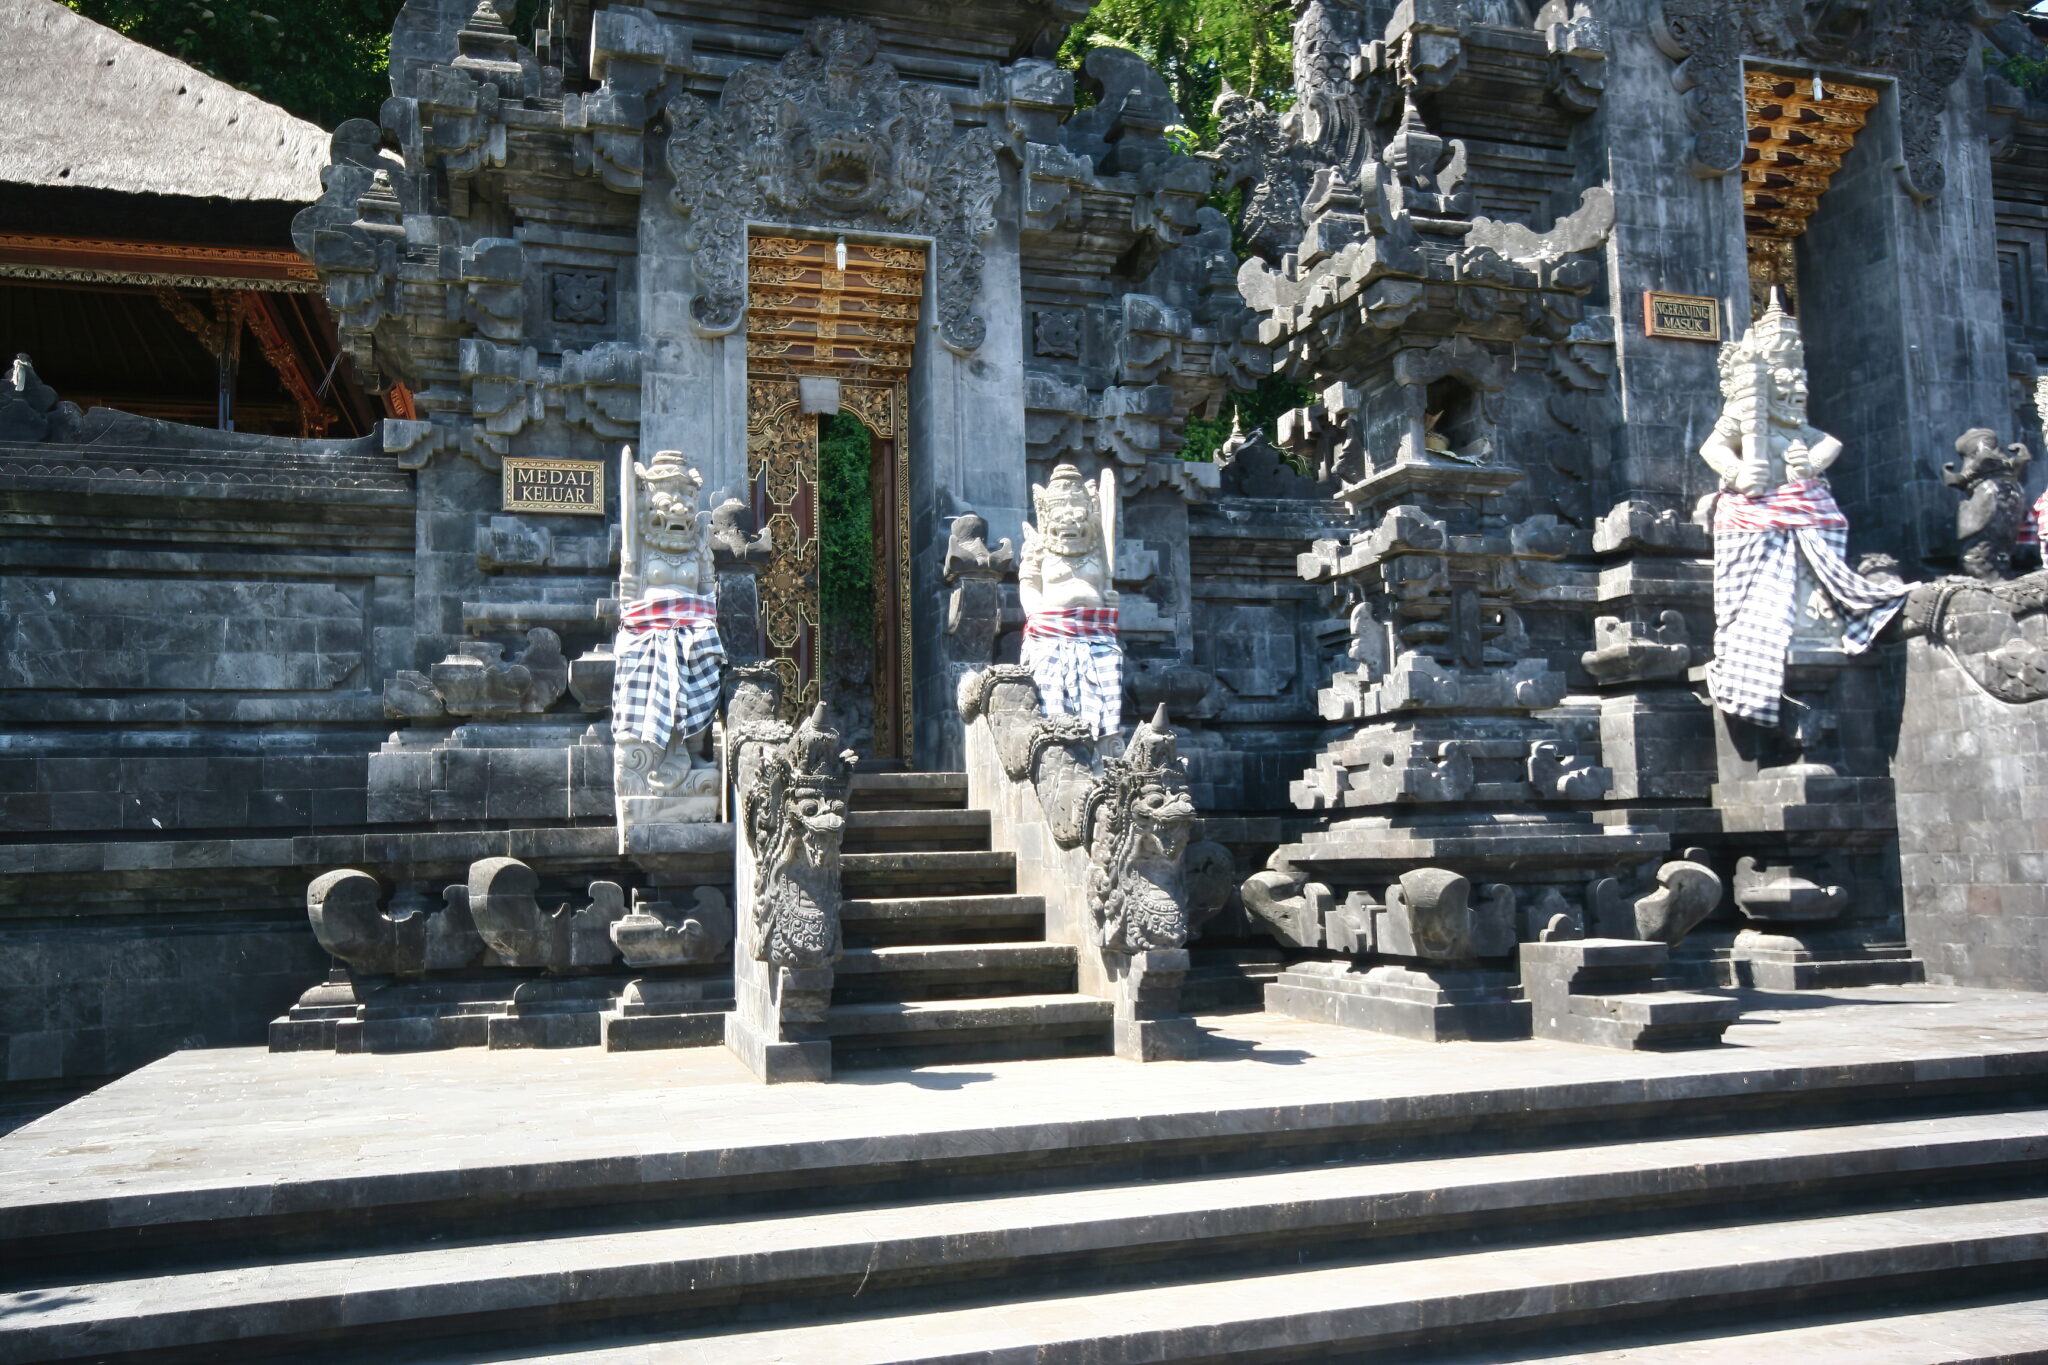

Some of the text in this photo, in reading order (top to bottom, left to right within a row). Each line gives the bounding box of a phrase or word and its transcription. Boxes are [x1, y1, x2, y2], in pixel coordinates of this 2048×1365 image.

[1663, 316, 1703, 331] MASUK
[517, 469, 591, 486] MEDAL
[521, 485, 585, 503] KELUAR
